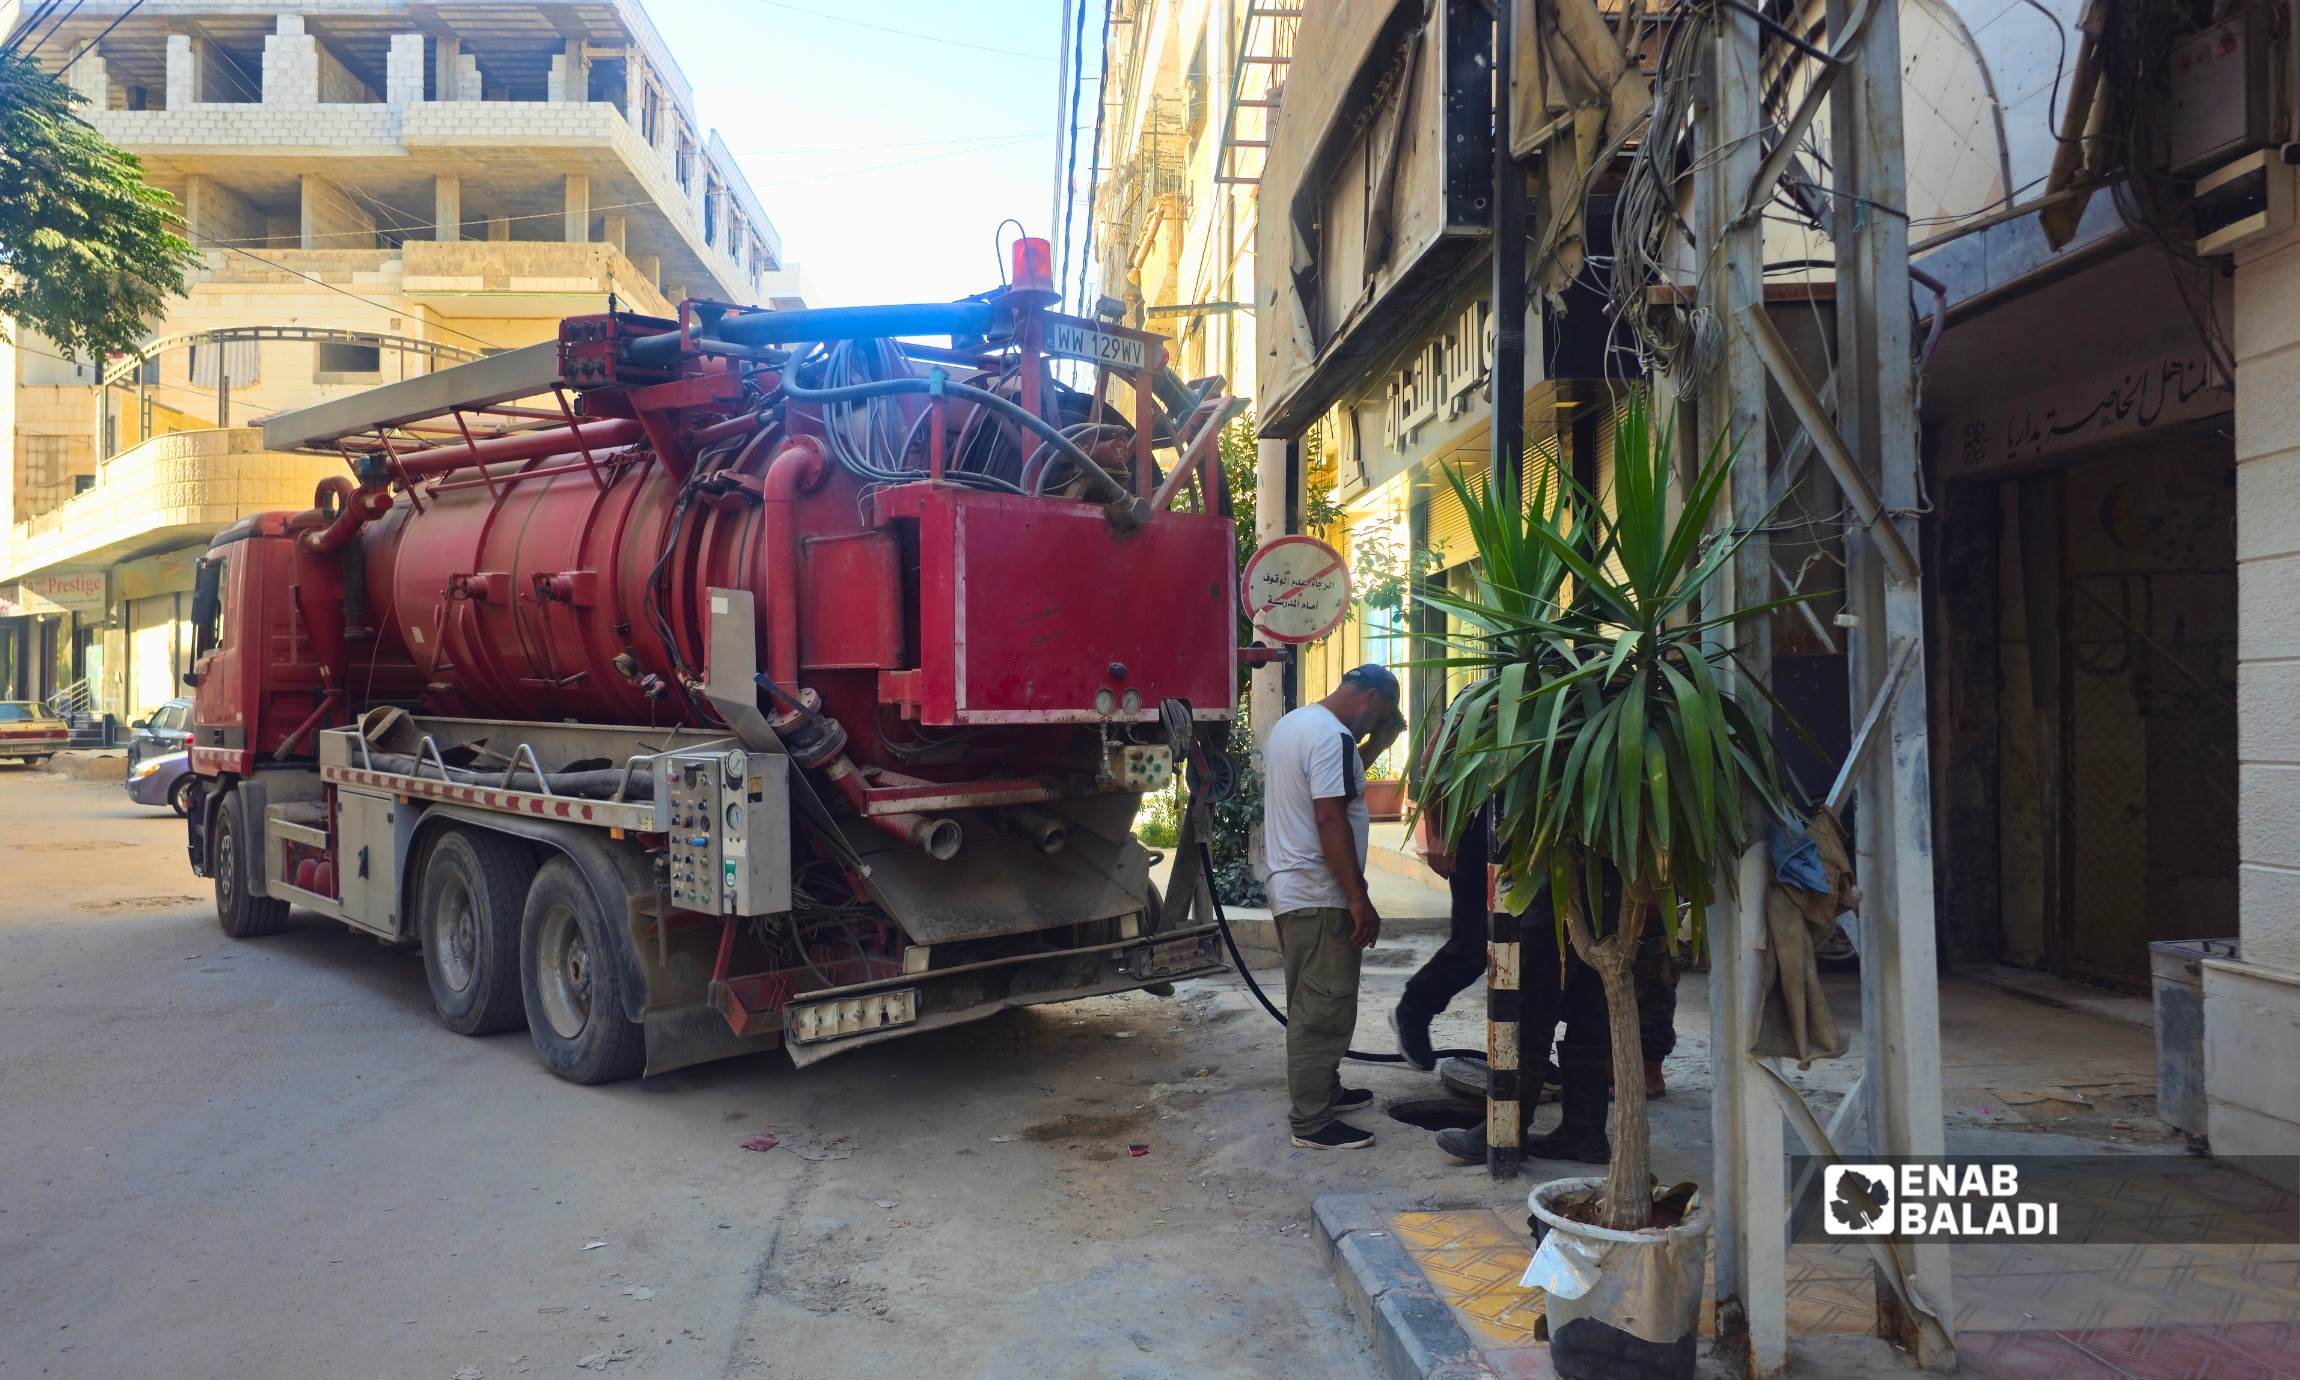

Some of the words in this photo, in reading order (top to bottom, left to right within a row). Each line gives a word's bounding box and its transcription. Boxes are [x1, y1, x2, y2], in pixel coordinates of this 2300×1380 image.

[1058, 326, 1084, 353] WW
[1092, 334, 1142, 364] 129WV
[49, 574, 101, 597] Prestige
[1291, 579, 1308, 587] عدم
[1268, 595, 1300, 607] المدرسة
